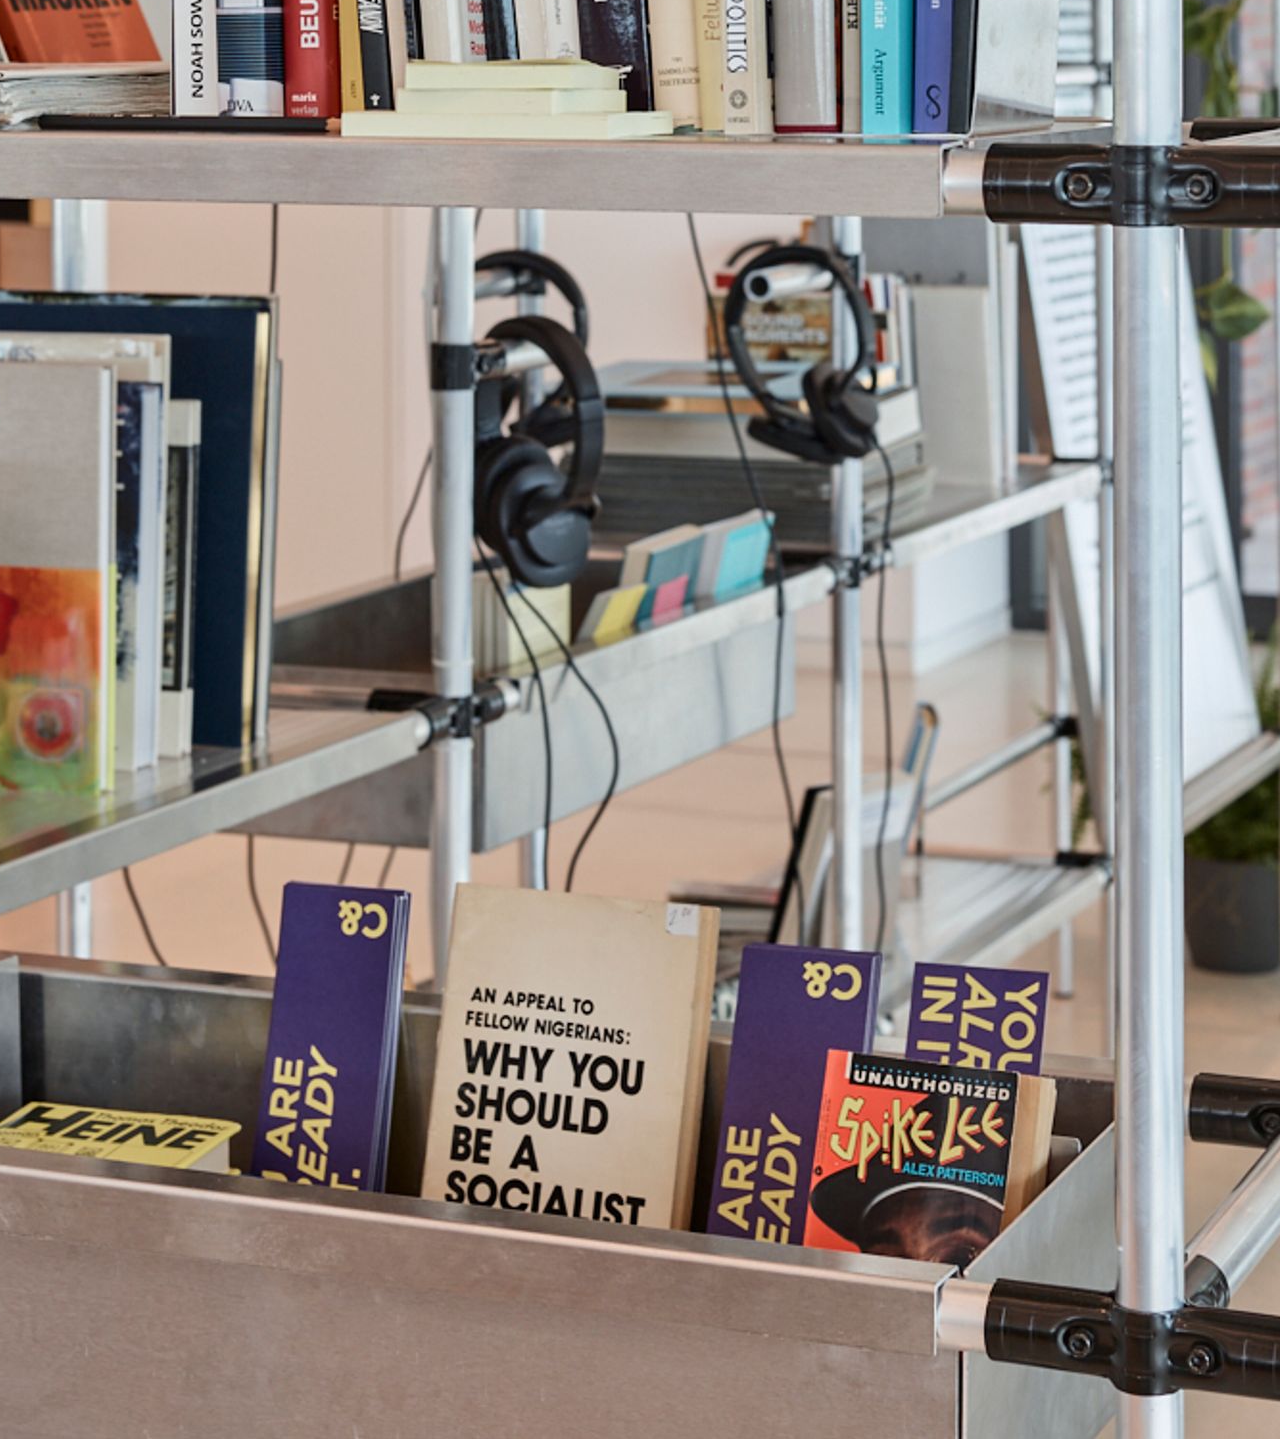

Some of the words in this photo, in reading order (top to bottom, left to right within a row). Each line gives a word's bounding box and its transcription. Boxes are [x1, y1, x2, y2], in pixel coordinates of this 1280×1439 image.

[190, 44, 204, 98] NOAH
[873, 49, 887, 115] Argument
[227, 99, 254, 112] DVA
[471, 987, 497, 1004] AN
[503, 991, 566, 1013] APPEAL
[573, 998, 595, 1016] TO
[920, 975, 958, 1024] IN
[465, 1011, 530, 1033] FELLOW
[534, 1019, 631, 1045] NIGERIANS:
[464, 1038, 555, 1084] WHY
[568, 1051, 645, 1096] YOU
[853, 1069, 1011, 1101] UNAUTHORIZED
[2, 1105, 220, 1151] HEINE
[266, 1057, 304, 1158] ARE
[296, 1045, 338, 1183] EADY
[455, 1081, 609, 1135] SHOULD
[939, 1095, 1008, 1166] LEE
[449, 1125, 494, 1165] BE
[509, 1134, 540, 1173] A
[901, 1162, 935, 1178] ALEX
[936, 1165, 1004, 1187] PATTERSON
[444, 1170, 646, 1226] SOCIALIST
[717, 1126, 762, 1231] ARE
